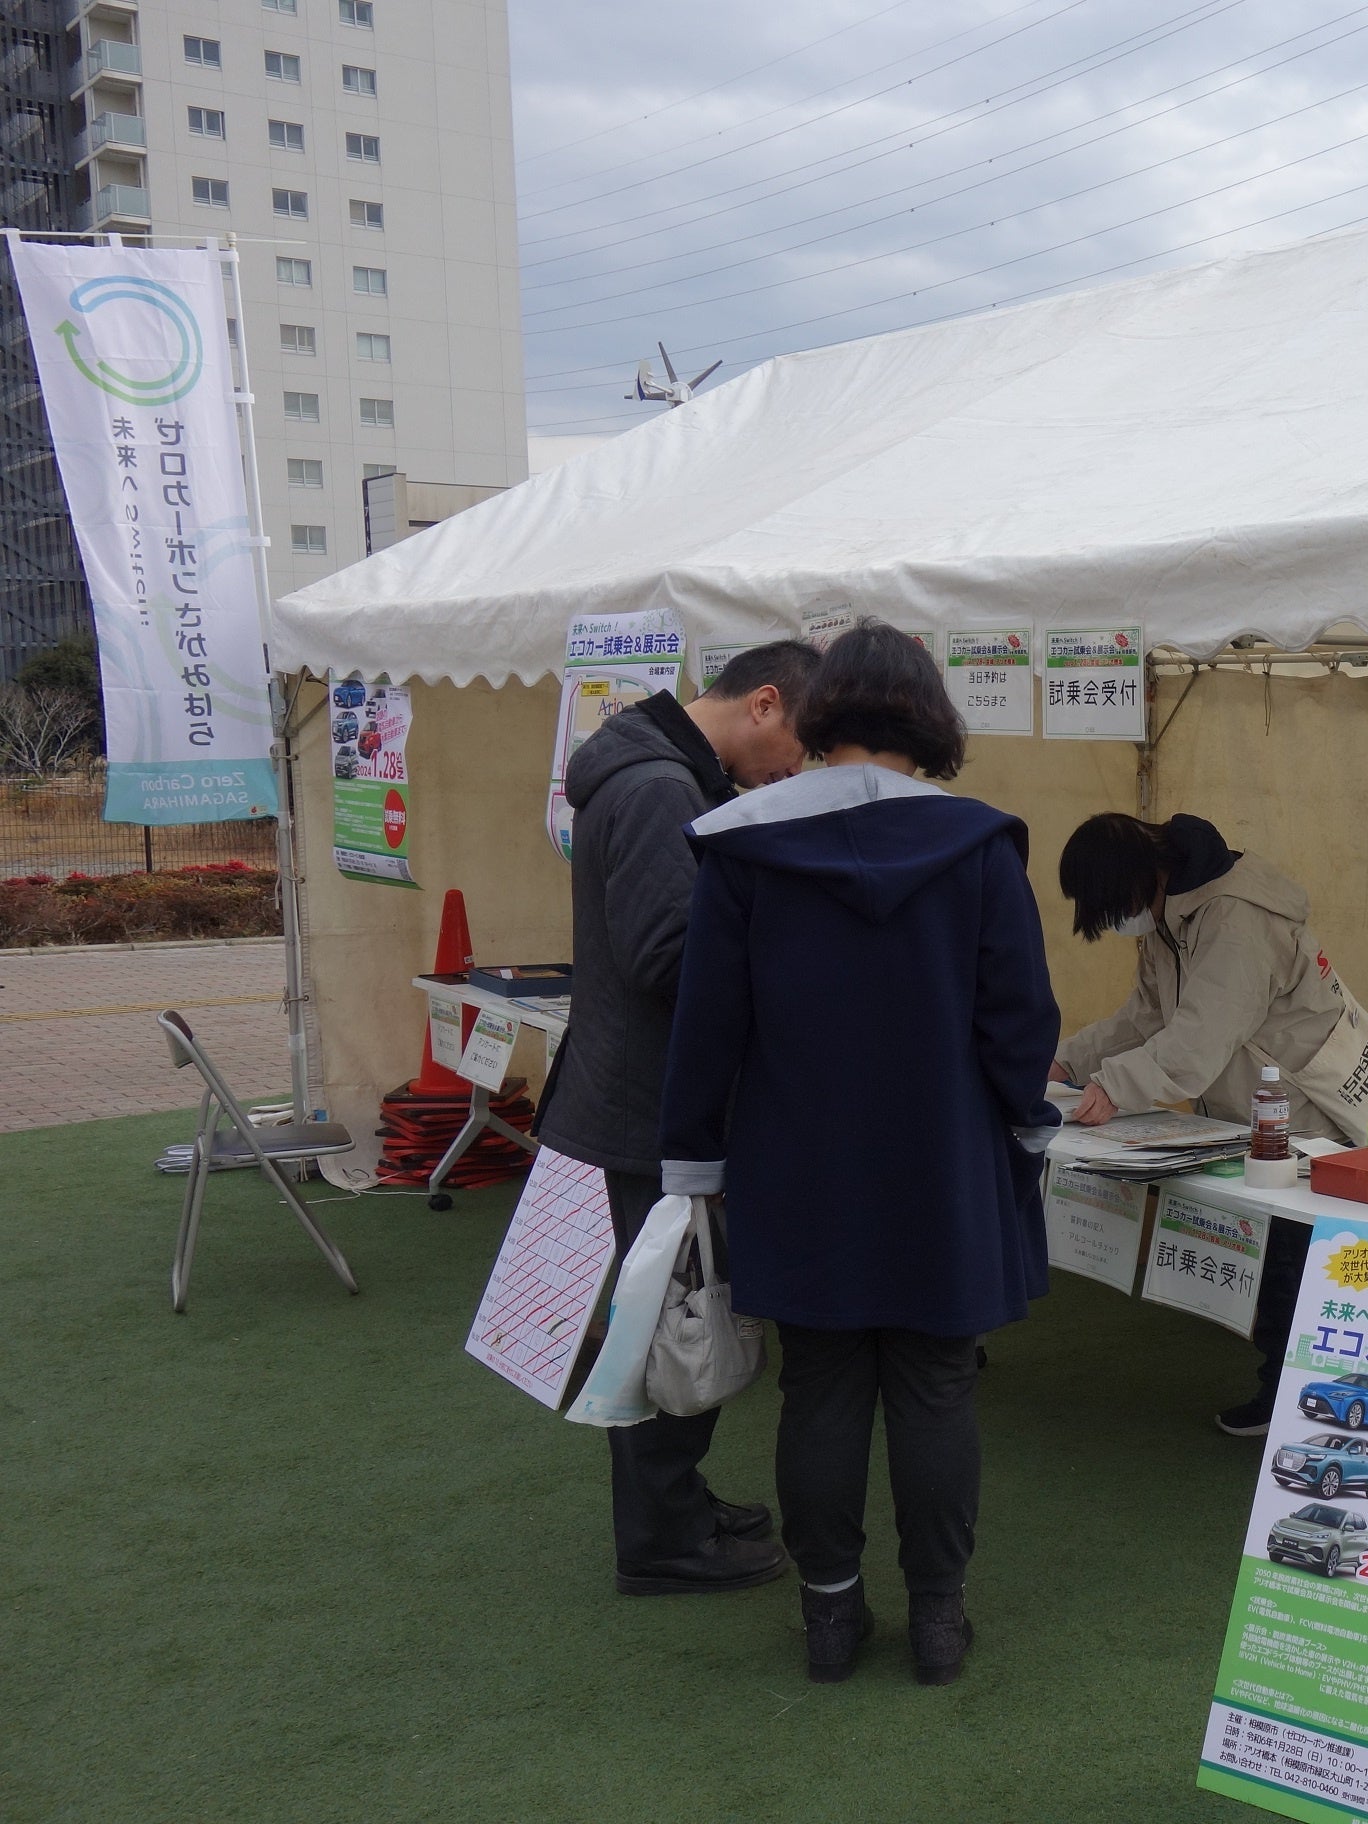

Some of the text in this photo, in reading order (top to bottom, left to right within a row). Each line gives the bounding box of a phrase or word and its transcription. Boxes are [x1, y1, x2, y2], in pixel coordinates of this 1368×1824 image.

[589, 622, 612, 634] Switch
[569, 633, 680, 658] エコカー試乗会&展示会
[967, 695, 1007, 707] こちらまで
[1049, 679, 1137, 706] 試乗会受付
[597, 697, 624, 716] Ario
[370, 748, 397, 780] 1.28
[1156, 1241, 1254, 1298] 試乗会受付
[1283, 1770, 1339, 1797] 042-810-0460
